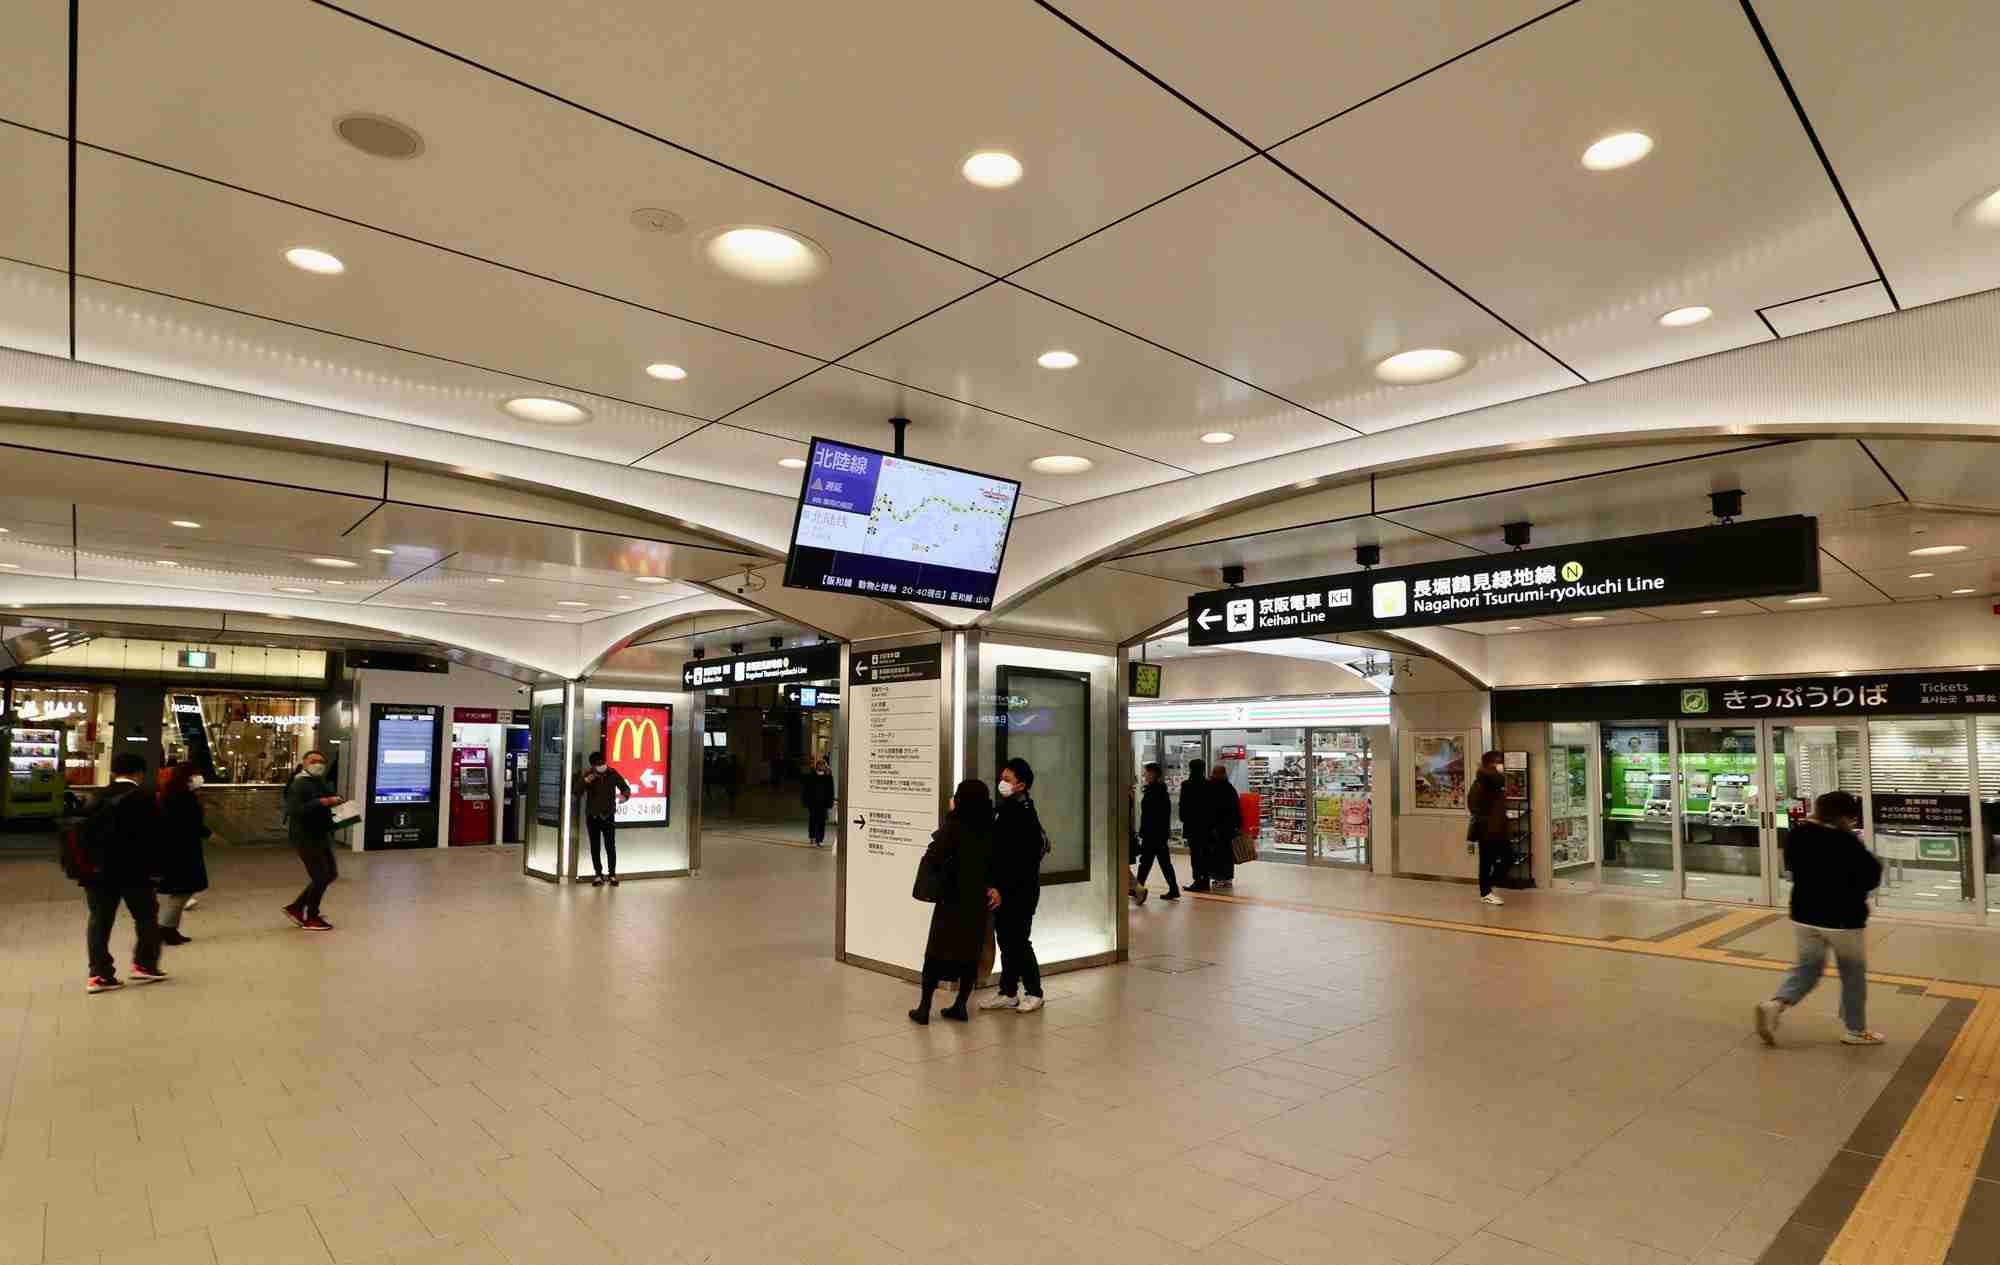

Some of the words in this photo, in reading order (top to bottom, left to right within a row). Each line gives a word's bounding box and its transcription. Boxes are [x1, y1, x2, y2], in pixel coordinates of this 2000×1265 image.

[813, 447, 869, 475] 北陸線
[1413, 564, 1556, 599] 長堀鶴見緑地線
[1414, 594, 1480, 613] Nagahori
[1485, 579, 1622, 606] Tsurumi-ryokuchi
[1627, 576, 1665, 592] Line
[1258, 593, 1322, 615] 京阪電車
[1329, 589, 1350, 605] KH
[1259, 612, 1298, 628] Keihan
[1301, 611, 1326, 624] Line
[1723, 682, 1888, 710] きっぷうりば
[1920, 682, 1968, 693] Tickets
